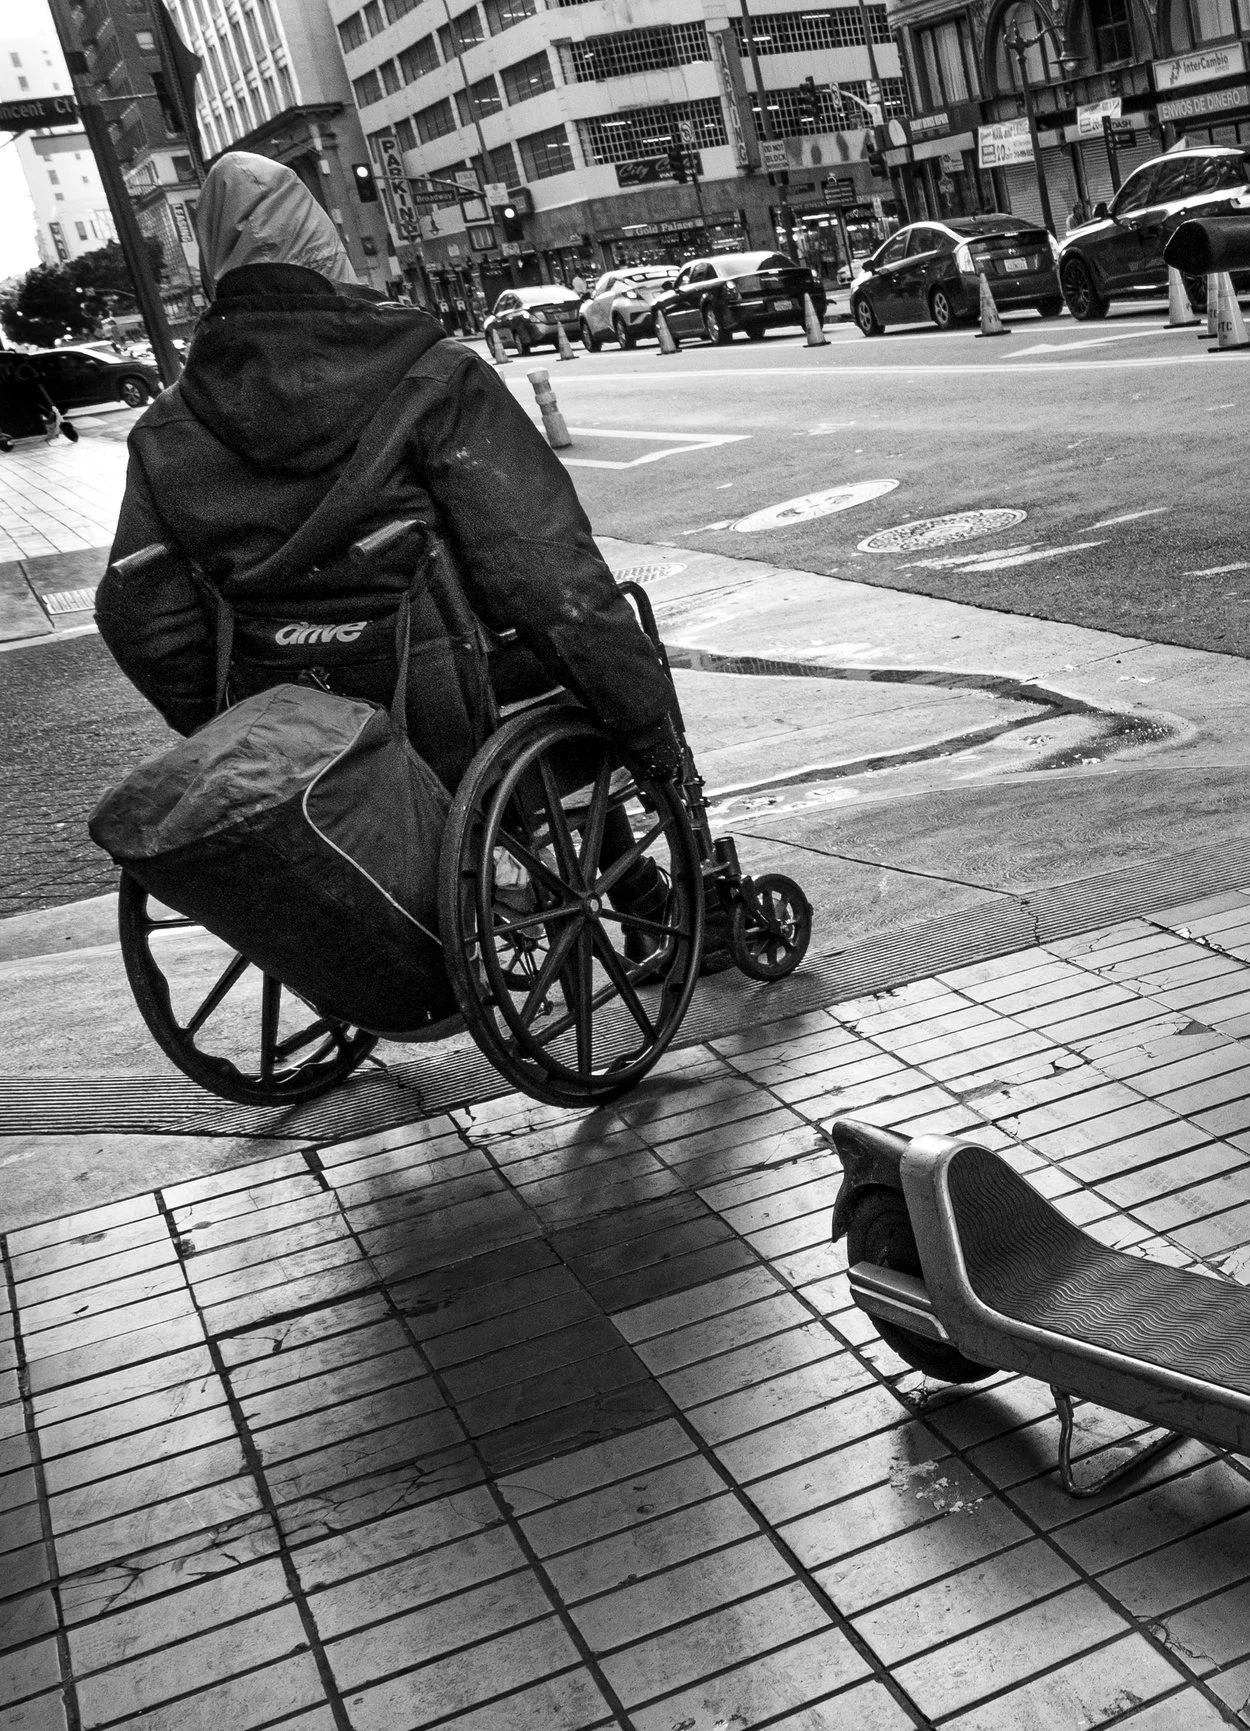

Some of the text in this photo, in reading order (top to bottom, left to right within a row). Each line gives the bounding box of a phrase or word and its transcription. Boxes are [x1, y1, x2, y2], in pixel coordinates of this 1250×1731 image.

[1183, 53, 1229, 73] InterCambio
[54, 98, 72, 114] Ct
[1162, 90, 1240, 119] ENVIOS DE DINERO
[619, 164, 650, 179] City
[635, 220, 694, 236] Gold Palace
